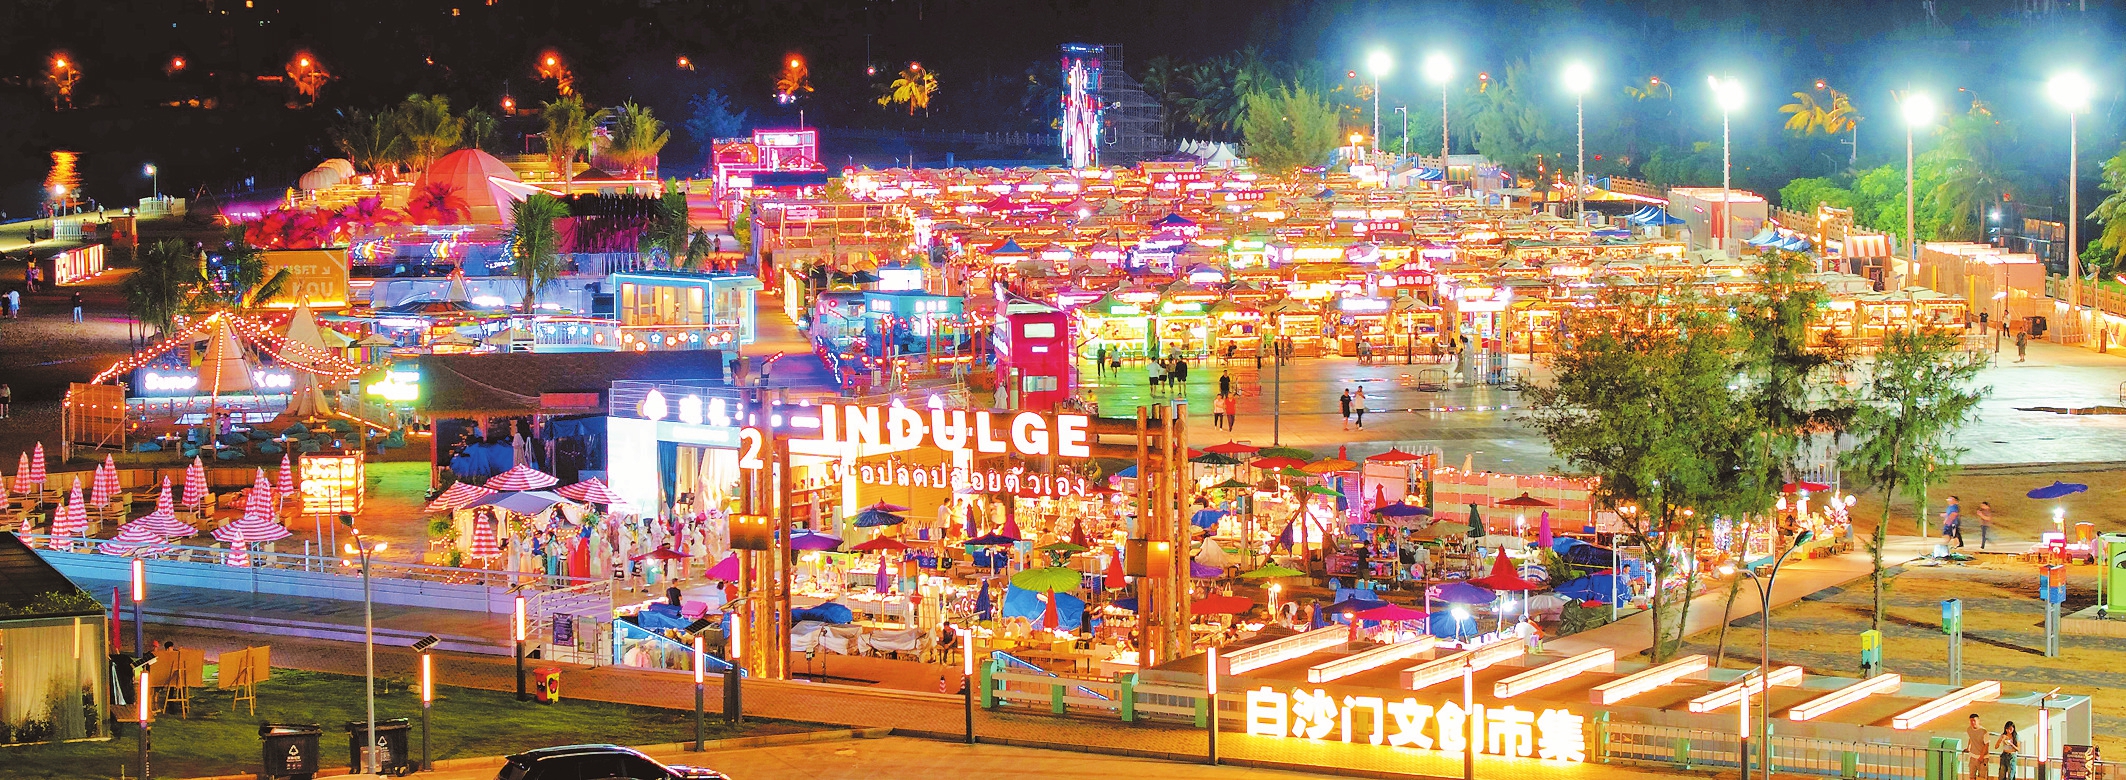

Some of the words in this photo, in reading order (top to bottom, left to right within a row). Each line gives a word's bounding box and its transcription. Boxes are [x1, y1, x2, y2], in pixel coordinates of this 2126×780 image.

[738, 427, 764, 470] 2
[821, 403, 1091, 458] INDULGE
[1246, 686, 1586, 763] 白沙门文创市集
